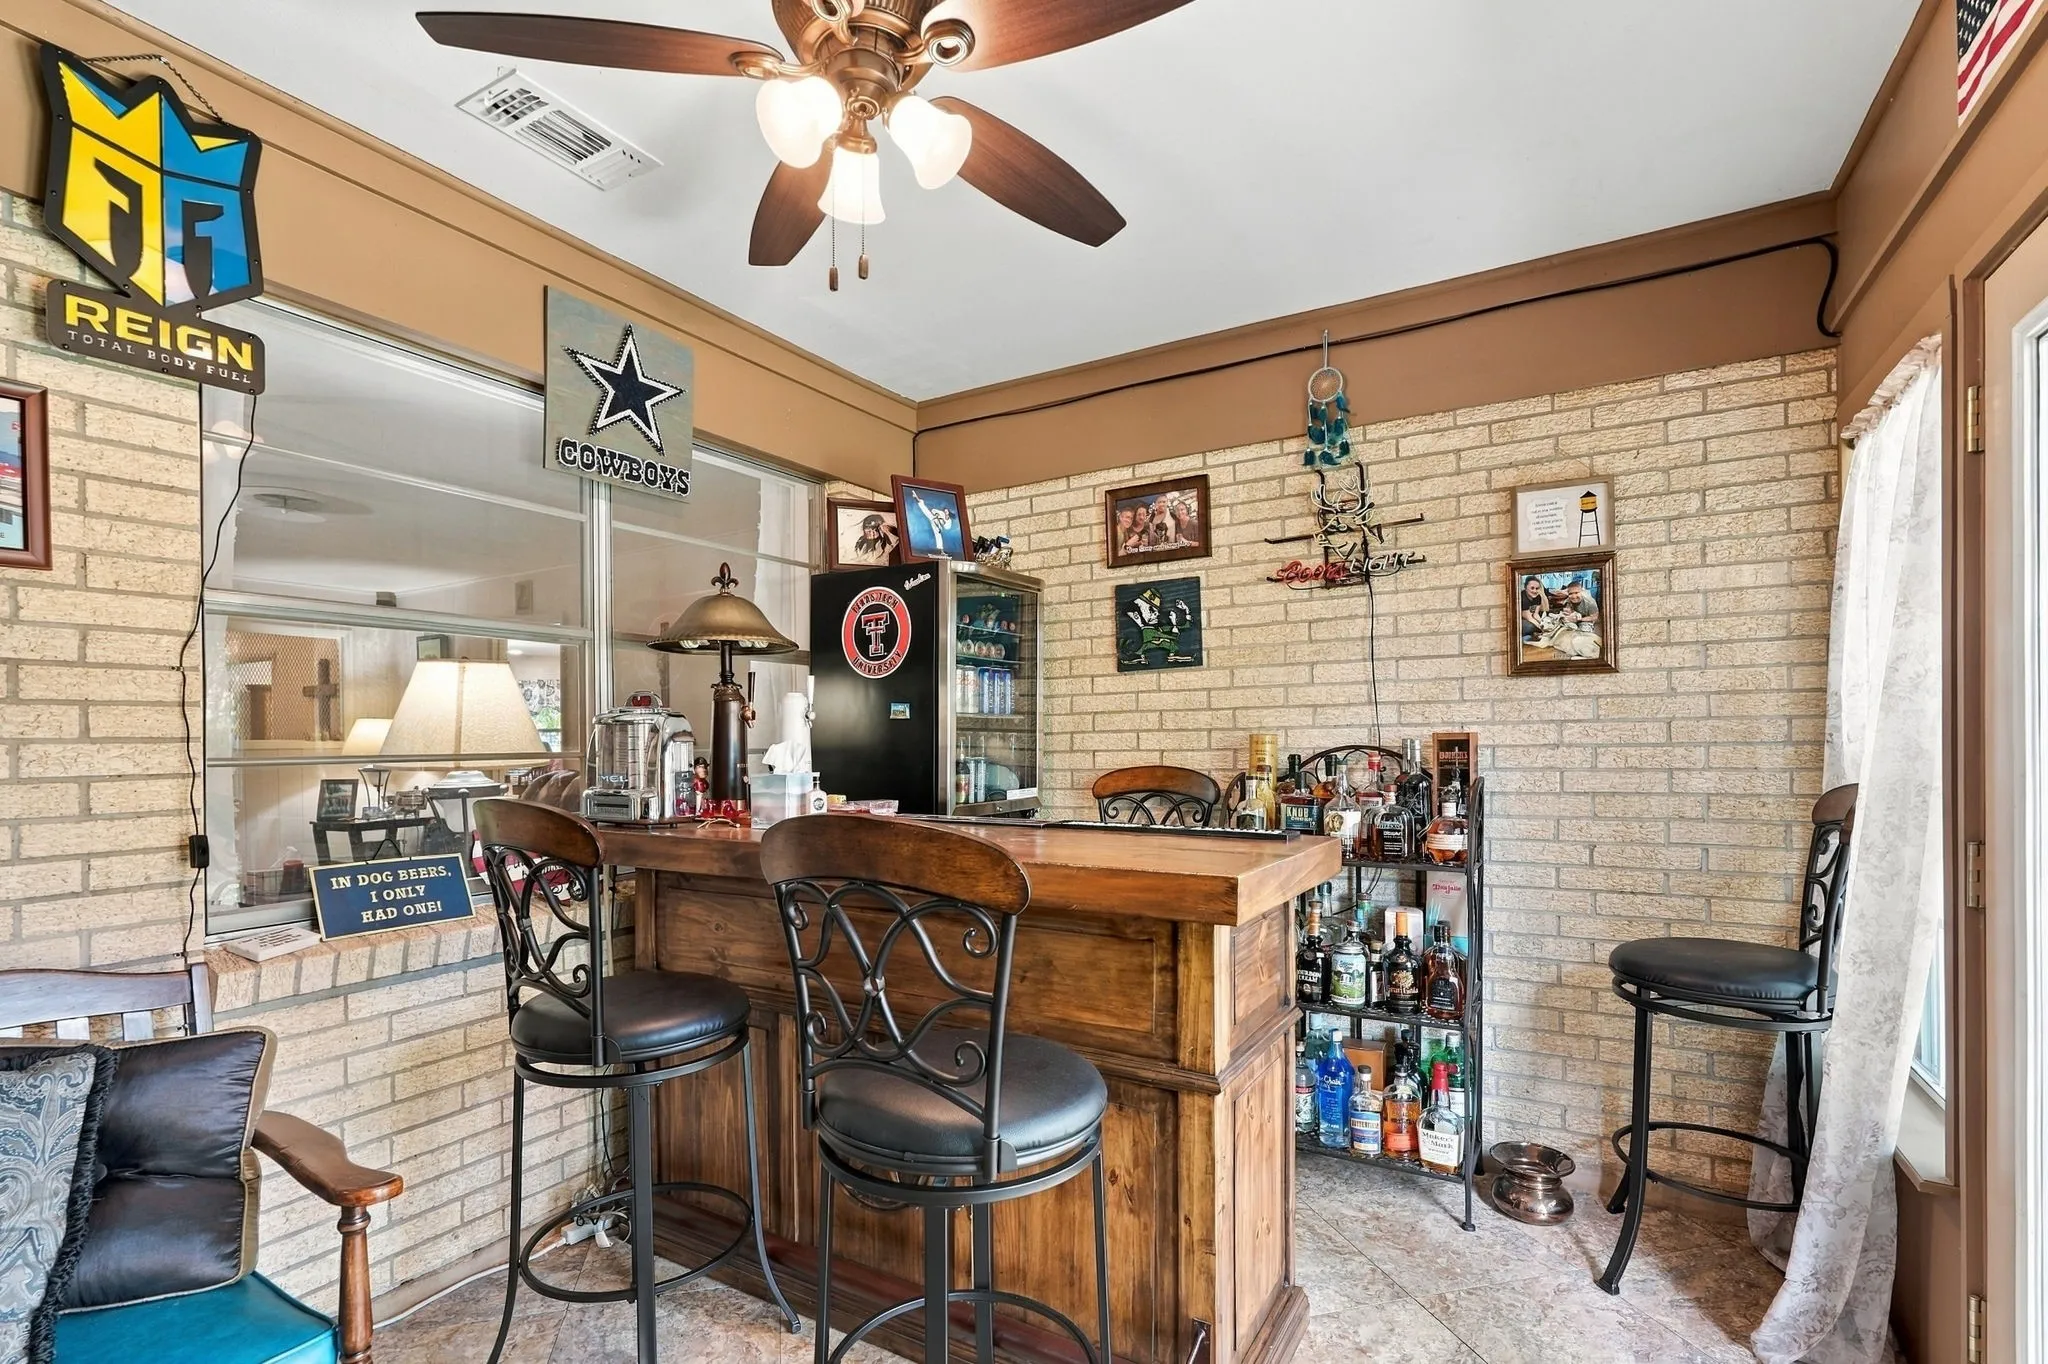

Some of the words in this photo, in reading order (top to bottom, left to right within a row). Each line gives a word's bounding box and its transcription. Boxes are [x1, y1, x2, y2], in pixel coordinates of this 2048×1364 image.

[65, 293, 254, 372] REIGN
[67, 330, 136, 355] TOTAL
[147, 350, 197, 371] BODY
[206, 364, 251, 384] FUEL
[557, 437, 691, 497] COWBOYS
[1350, 551, 1415, 574] LIGHT
[851, 593, 876, 613] TEXAS
[879, 592, 899, 609] TECH
[853, 650, 903, 674] UNIVERSITY
[1286, 806, 1309, 818] KNOB
[330, 875, 352, 890] IN
[356, 871, 394, 887] DOG
[397, 865, 452, 881] BEERS,
[369, 891, 378, 903] I
[383, 885, 426, 901] ONLY
[361, 907, 398, 923] HAD
[402, 900, 443, 916] ONE!
